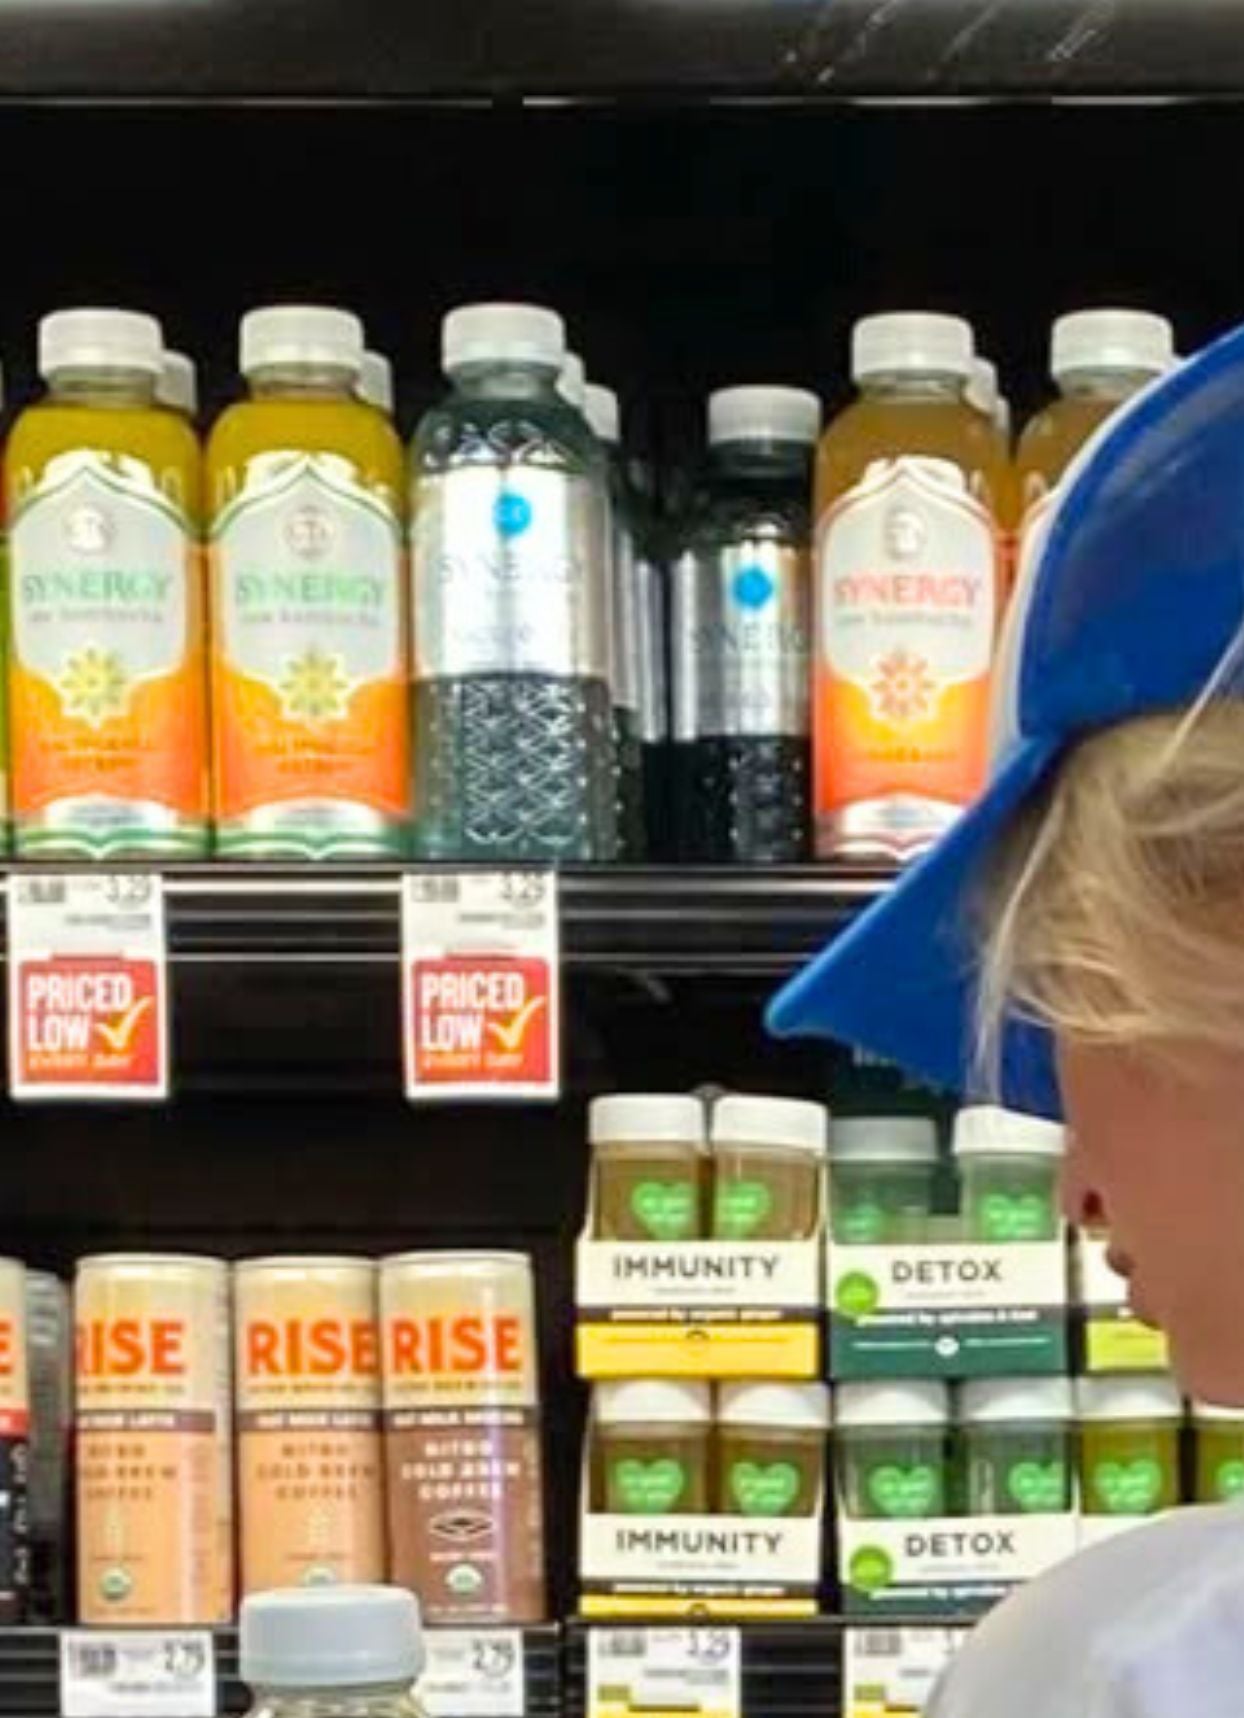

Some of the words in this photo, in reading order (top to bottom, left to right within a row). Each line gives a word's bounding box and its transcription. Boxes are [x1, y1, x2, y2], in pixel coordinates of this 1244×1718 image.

[27, 973, 134, 1010] PRICED
[421, 972, 525, 1010] PRICED
[27, 1013, 90, 1051] LOW
[421, 1012, 484, 1051] LOW
[612, 1254, 780, 1279] IMMUNITY
[891, 1258, 1004, 1285] DETOX
[246, 1320, 379, 1378] RISE
[391, 1315, 521, 1377] RISE
[616, 1527, 783, 1555] IMMUNITY
[904, 1529, 1016, 1558] DETOX
